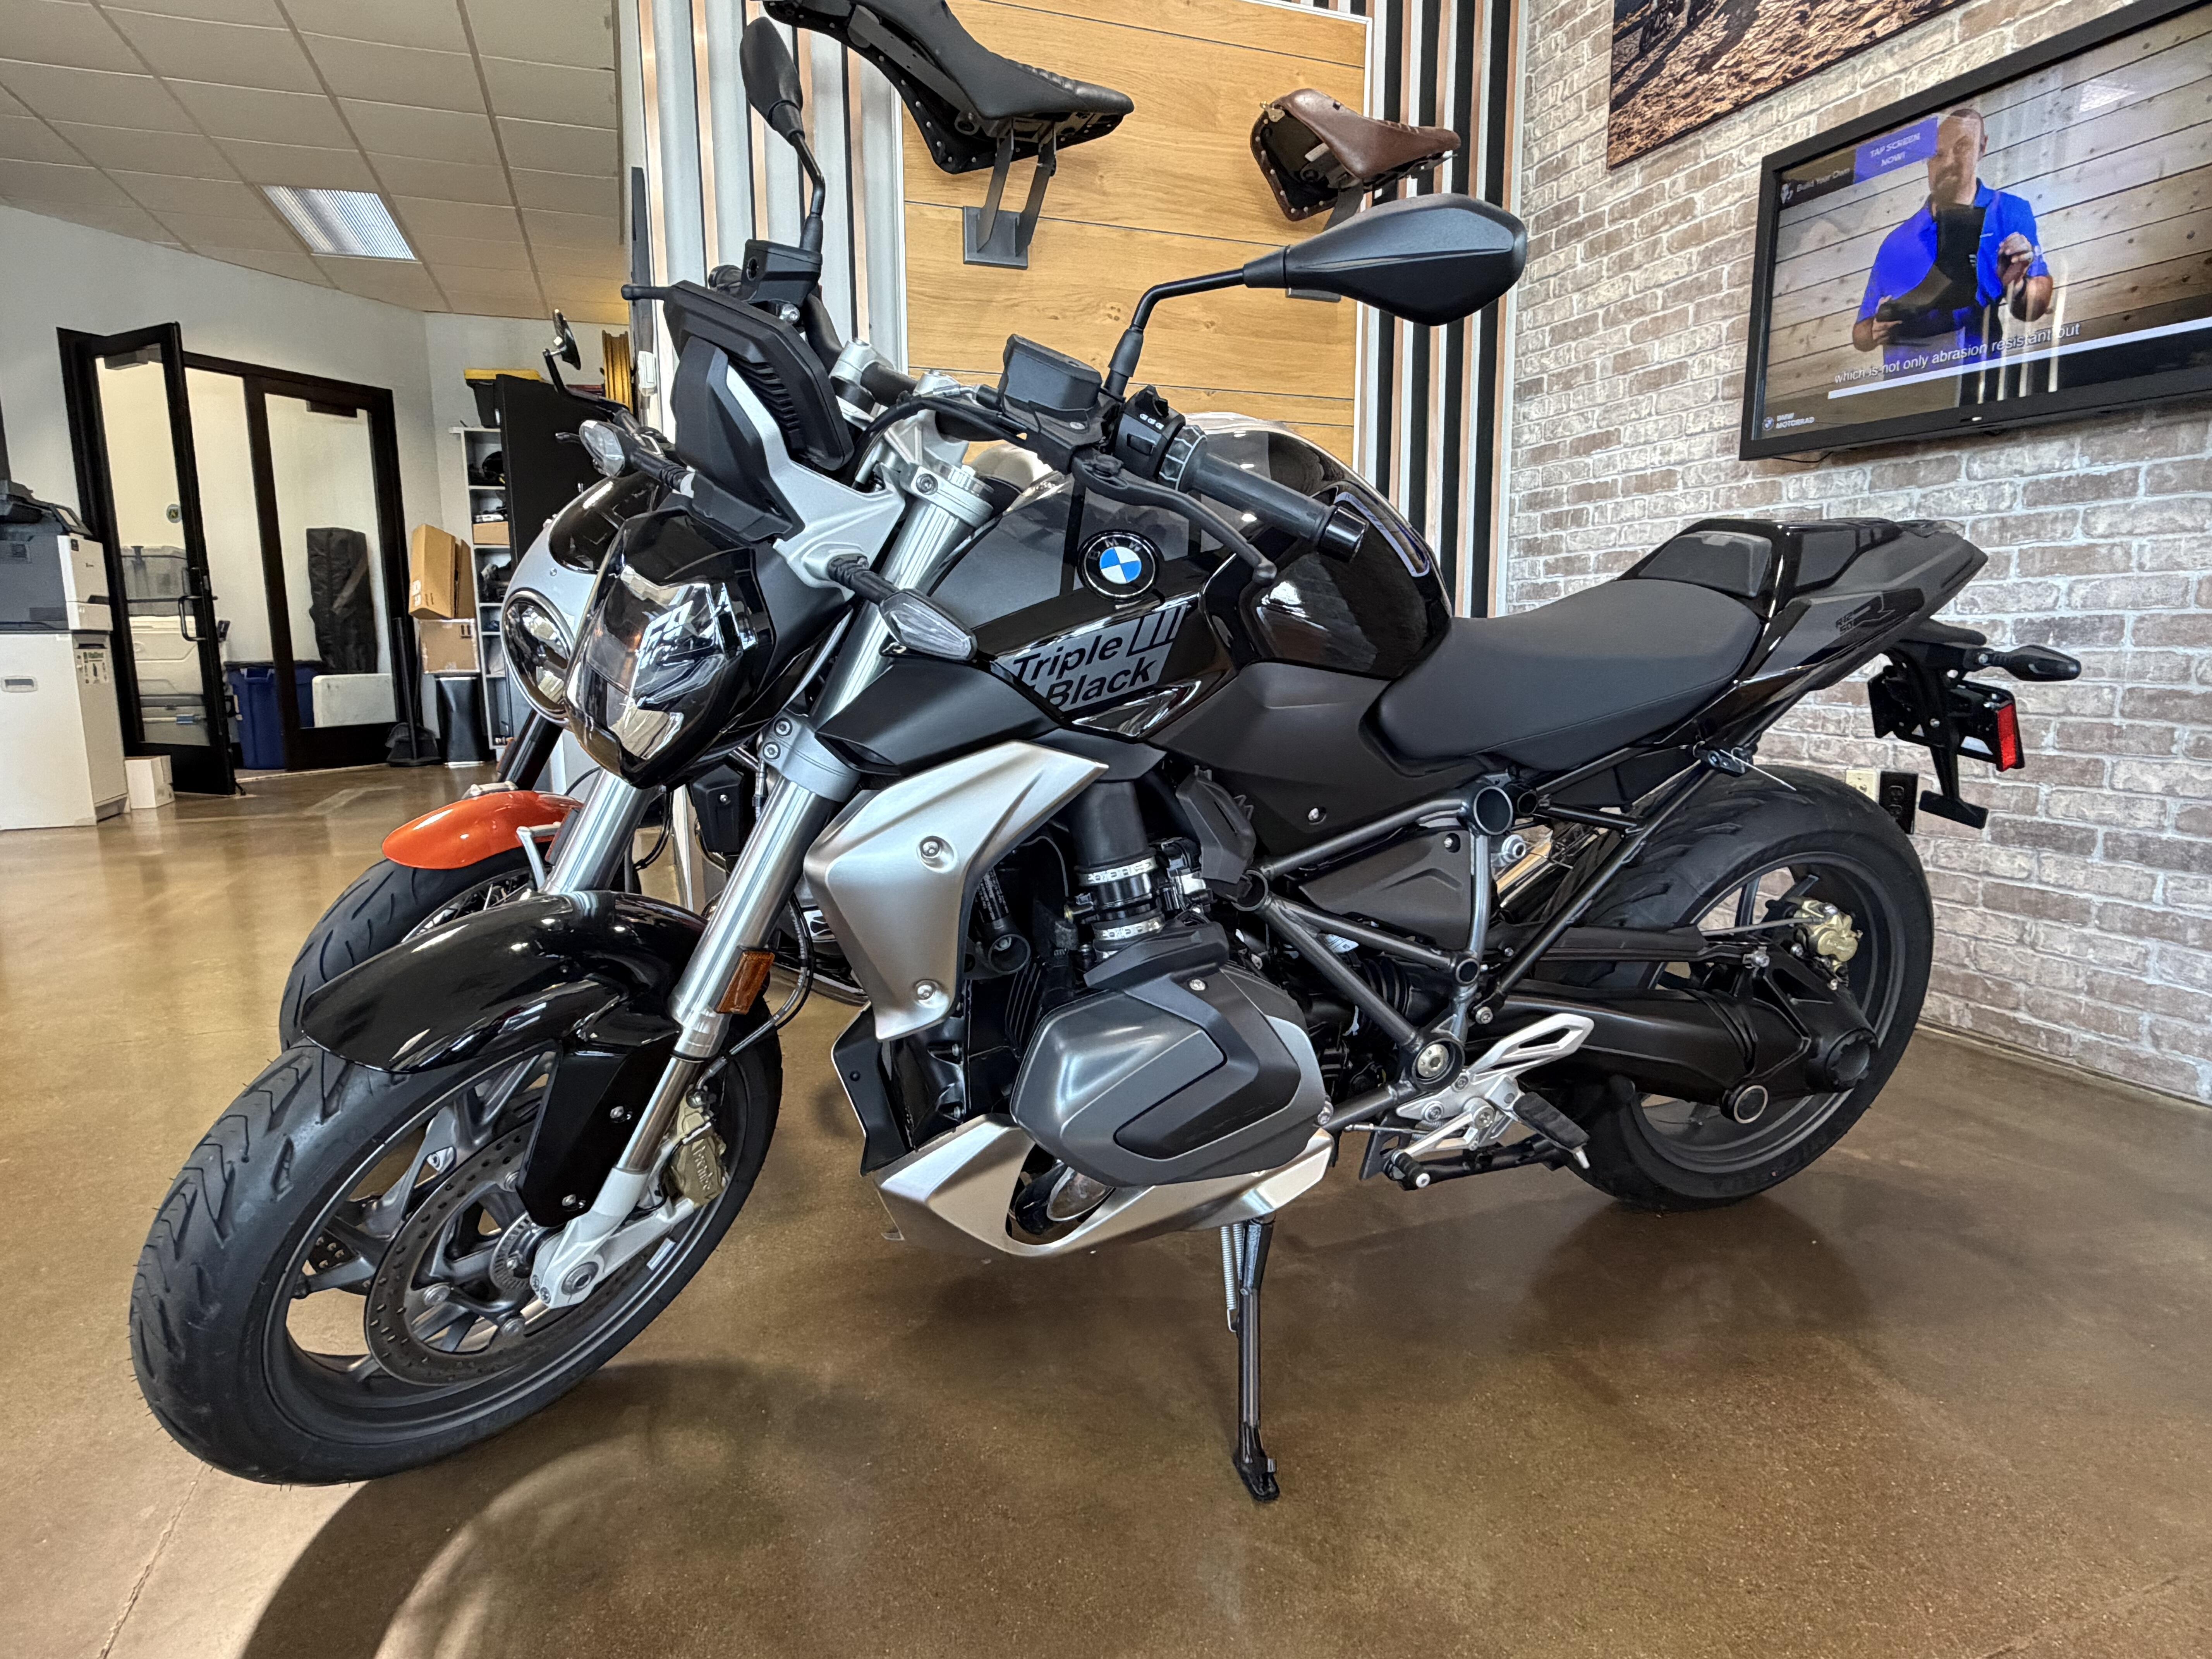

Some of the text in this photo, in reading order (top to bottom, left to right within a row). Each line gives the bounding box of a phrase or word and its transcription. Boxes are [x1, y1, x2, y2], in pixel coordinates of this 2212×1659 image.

[1870, 132, 1920, 158] TAP SCREEN
[1835, 370, 1865, 383] which
[1868, 366, 1878, 377] is
[1881, 360, 1899, 374] not
[1903, 355, 1929, 369] only
[1932, 344, 1987, 364] abrasion
[1992, 329, 2051, 352] resistant
[1087, 537, 1142, 561] BMW
[1013, 634, 1123, 681] Triple
[1046, 657, 1157, 708] Black
